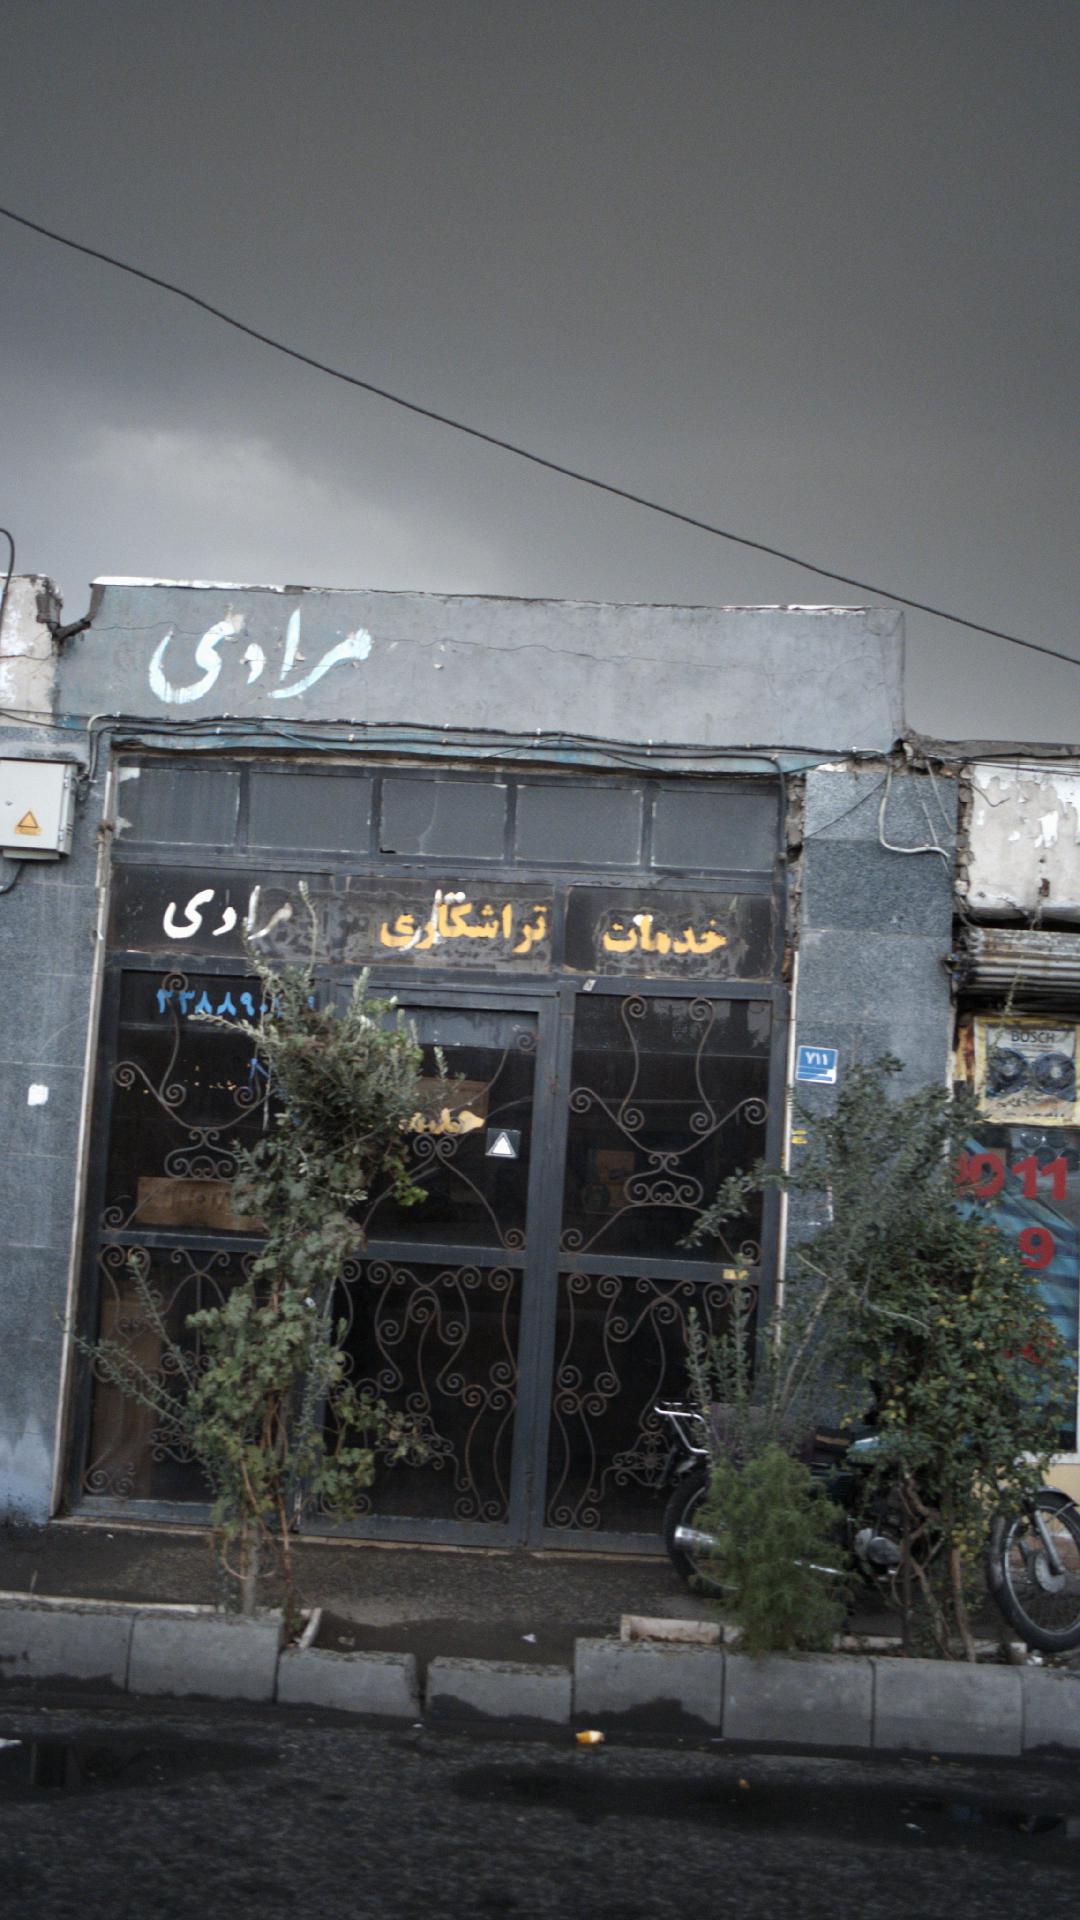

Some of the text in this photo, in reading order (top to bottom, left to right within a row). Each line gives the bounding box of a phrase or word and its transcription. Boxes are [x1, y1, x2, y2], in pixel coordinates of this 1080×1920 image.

[147, 606, 375, 705] مرادی
[379, 897, 728, 955] خدمات تراشکاری
[1011, 1030, 1056, 1043] BOSCH
